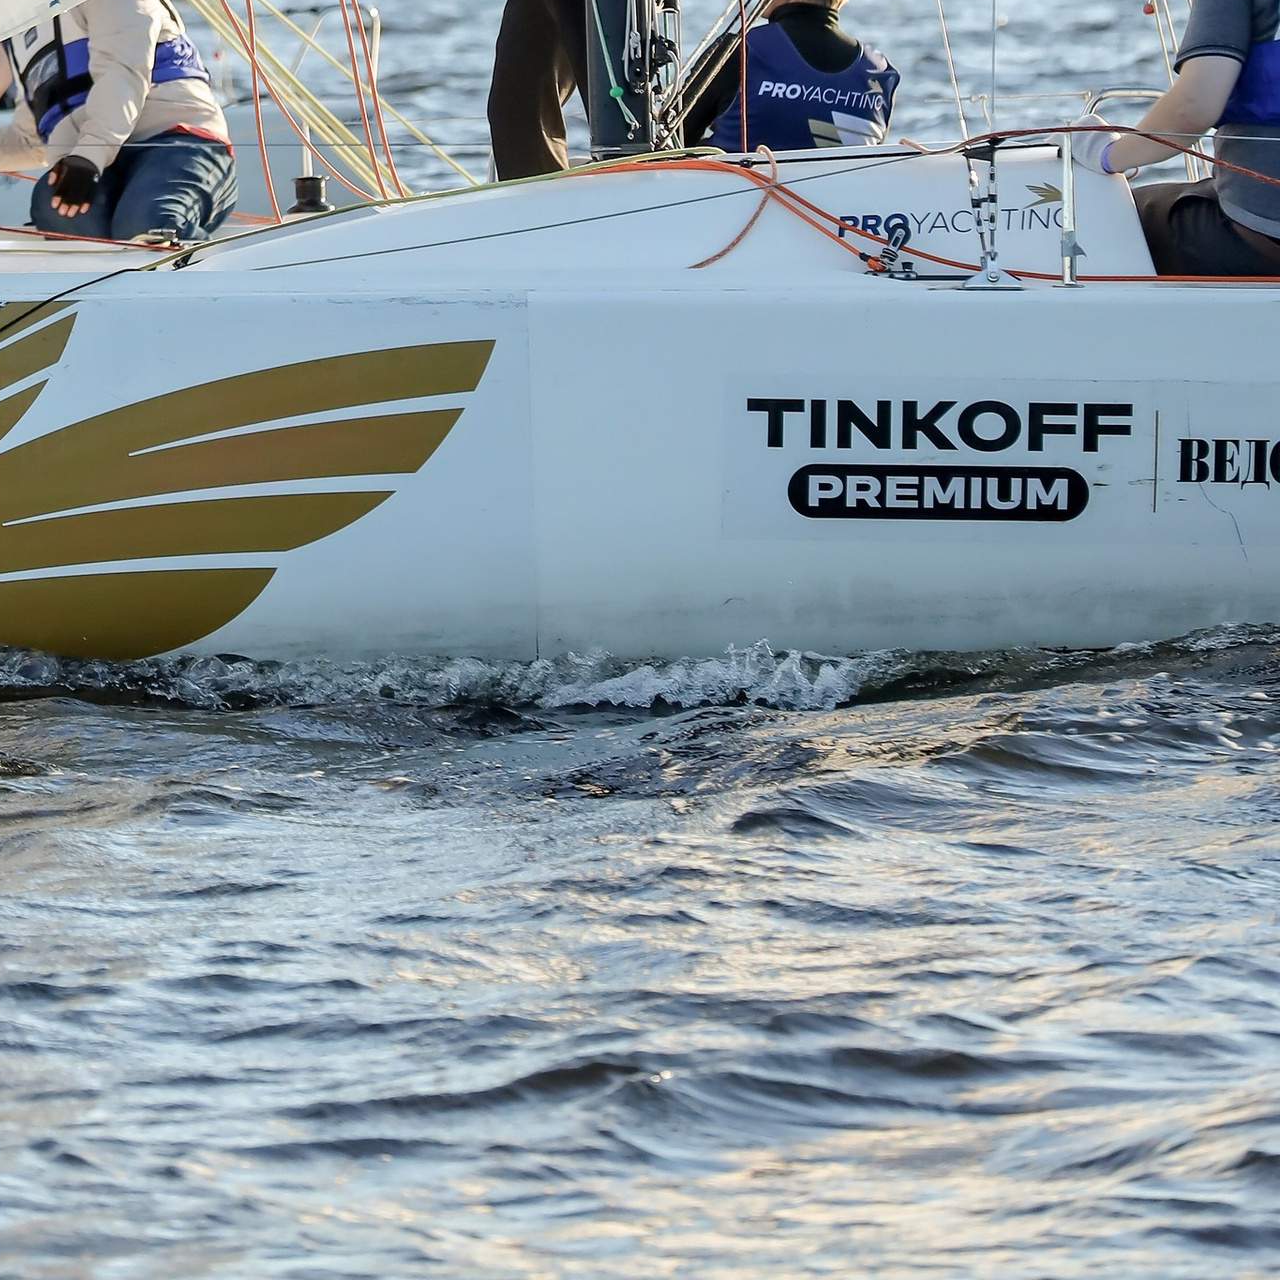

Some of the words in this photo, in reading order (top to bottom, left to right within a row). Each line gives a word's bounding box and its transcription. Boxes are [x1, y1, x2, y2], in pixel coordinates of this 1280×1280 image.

[746, 397, 1134, 453] TINKOFF
[1176, 438, 1280, 491] ВЕД
[808, 474, 1069, 511] PREMIUM
